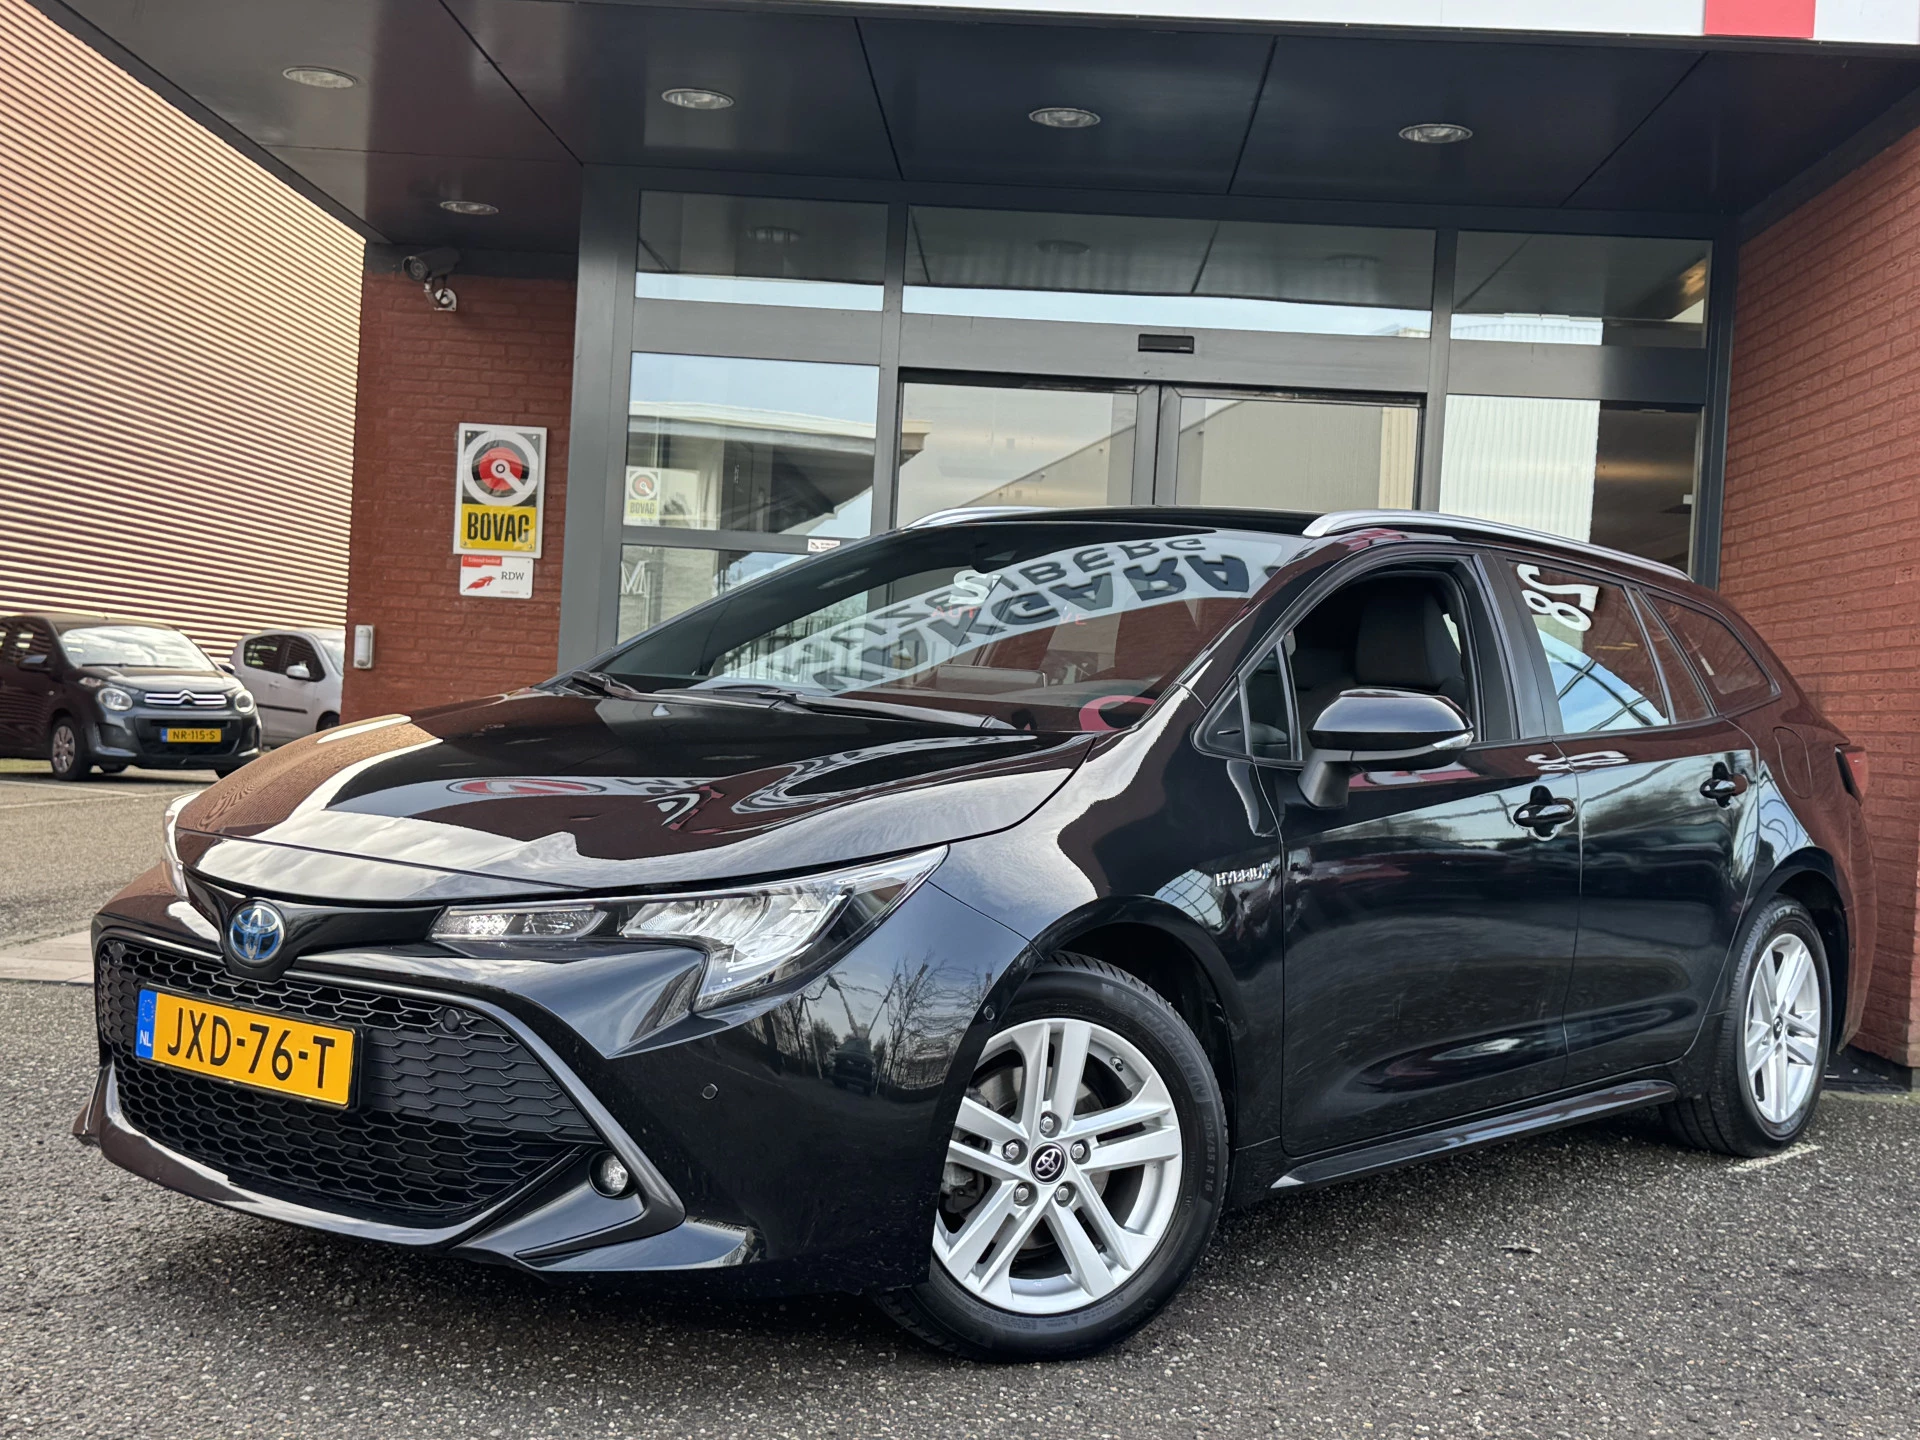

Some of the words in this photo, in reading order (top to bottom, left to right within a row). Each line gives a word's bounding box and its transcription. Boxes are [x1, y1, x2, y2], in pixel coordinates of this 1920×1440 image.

[630, 502, 655, 514] BOVAG
[467, 511, 530, 543] BOVAG
[501, 571, 525, 581] RDW
[139, 1029, 152, 1047] NL
[167, 1007, 335, 1089] JXD-76-T
